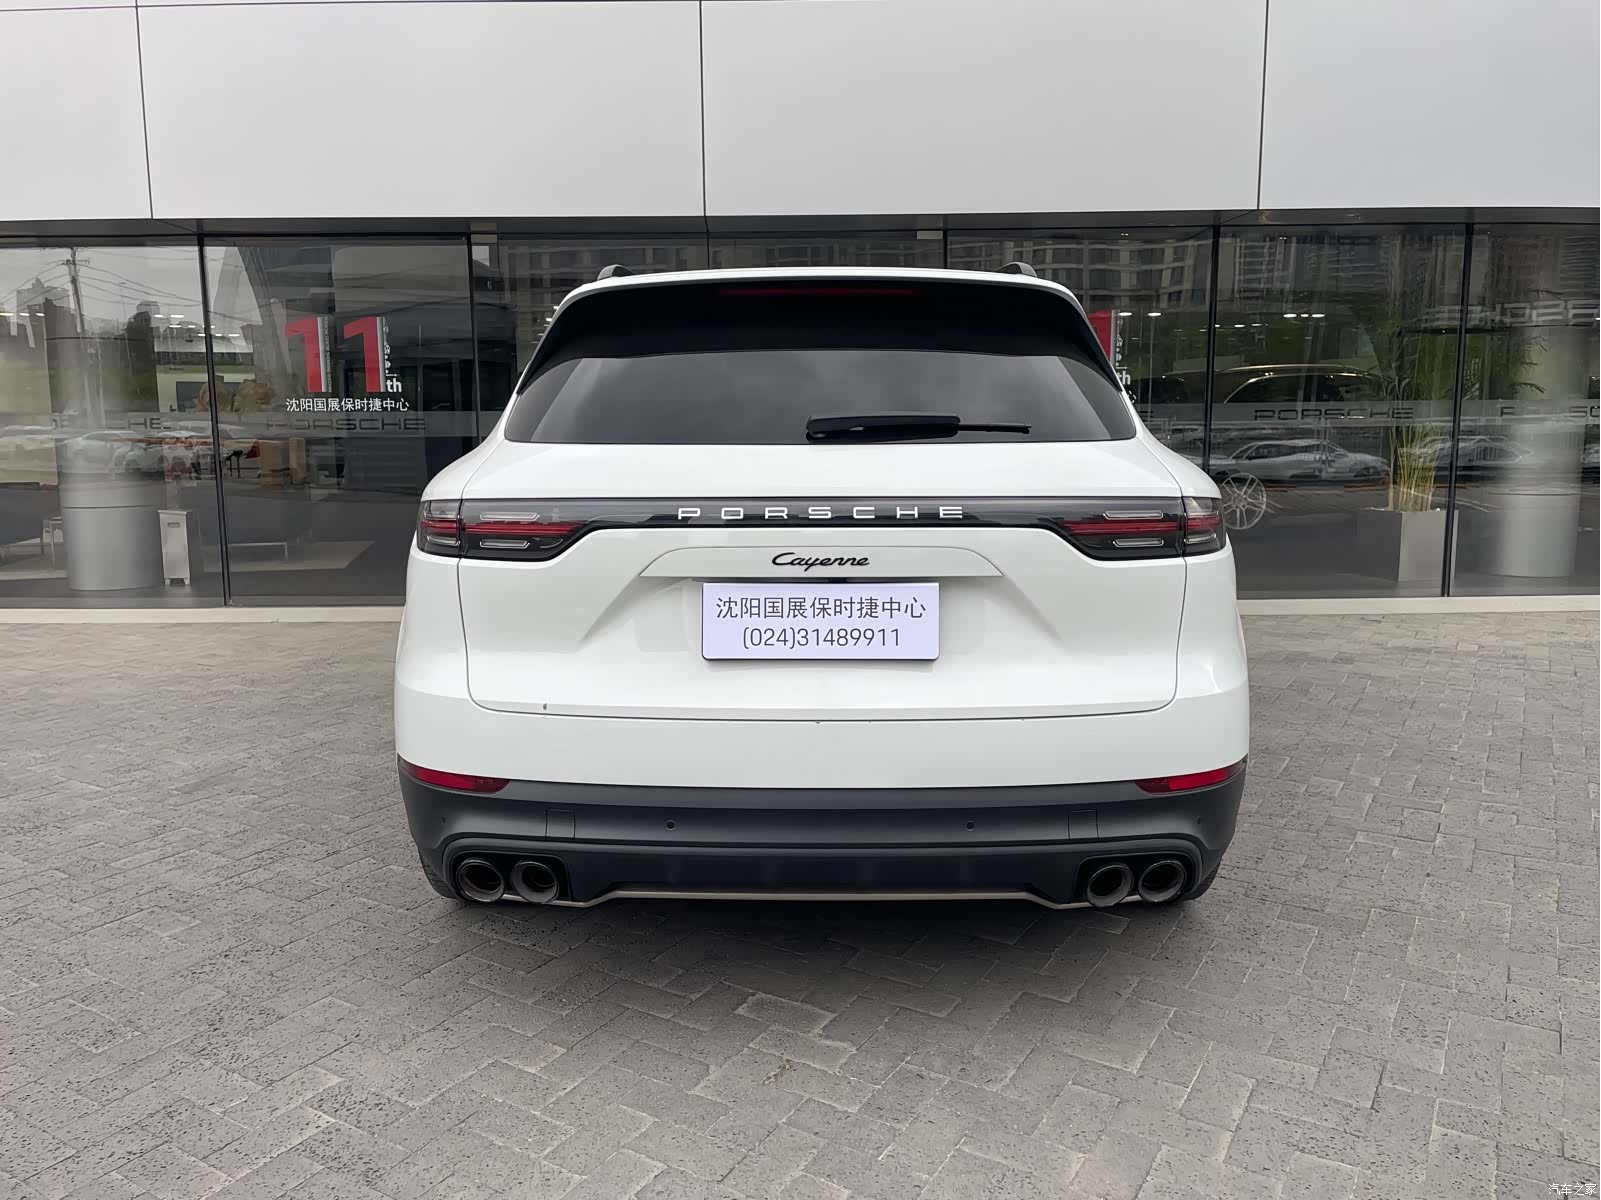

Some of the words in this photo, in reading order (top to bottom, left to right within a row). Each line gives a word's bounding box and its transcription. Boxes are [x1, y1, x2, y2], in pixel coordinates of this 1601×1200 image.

[286, 398, 410, 412] 沈阳国展保时捷中心
[1253, 407, 1414, 421] PORSCHE
[677, 506, 964, 520] PORSCHE
[771, 551, 871, 572] Cayenne
[715, 596, 927, 620] 沈阳国展保时捷中心
[742, 627, 901, 650] (024)31489911
